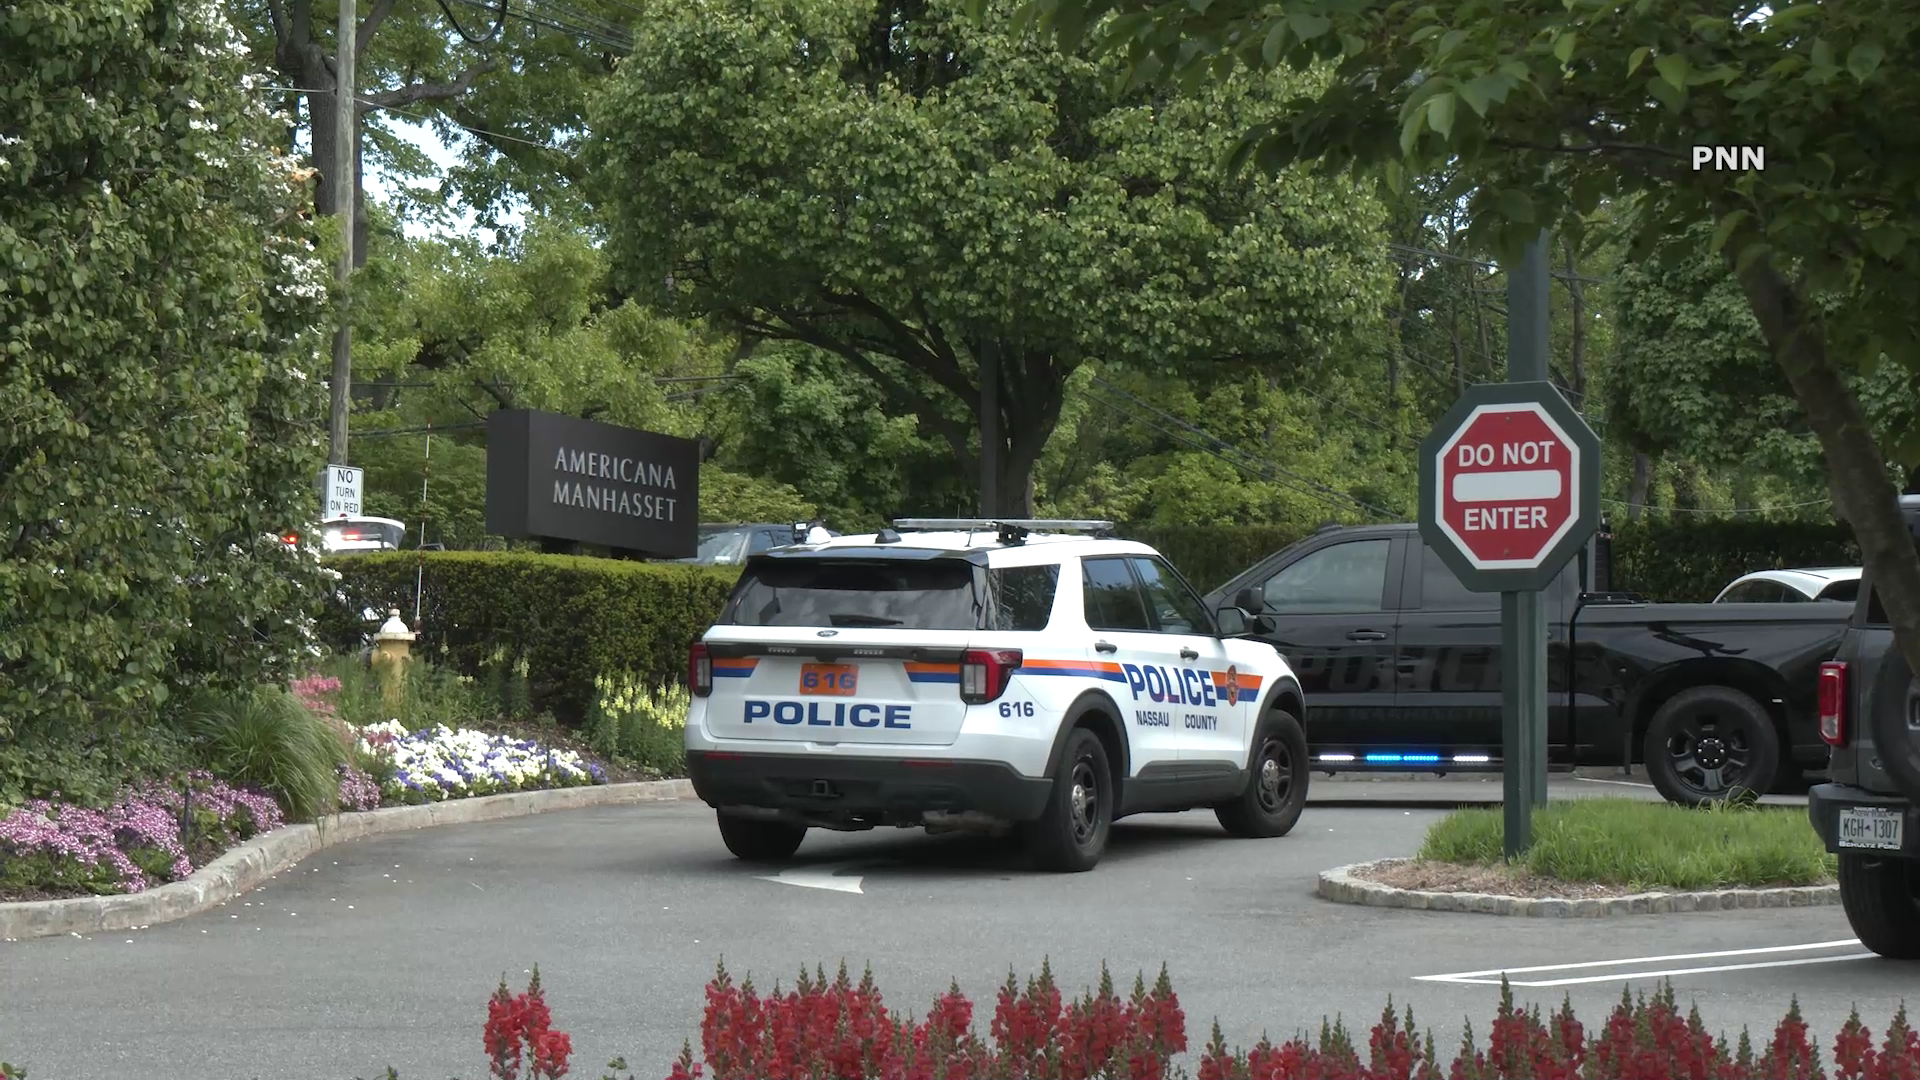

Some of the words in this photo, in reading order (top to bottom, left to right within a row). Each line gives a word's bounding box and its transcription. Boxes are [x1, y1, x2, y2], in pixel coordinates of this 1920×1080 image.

[1458, 443, 1495, 467] DO
[1502, 440, 1555, 465] NOT
[337, 469, 354, 484] NO
[554, 446, 676, 490] AMERICANA
[335, 486, 356, 499] TURN
[553, 480, 676, 522] MANHASSET
[330, 500, 341, 511] ON
[343, 502, 359, 513] RED
[1464, 506, 1548, 531] ENTER
[803, 671, 856, 689] 616
[1121, 663, 1217, 708] POLICE
[743, 700, 912, 729] POLICE
[998, 701, 1035, 718] 616
[1135, 710, 1170, 728] NASSAU
[1184, 713, 1218, 731] COUNTY
